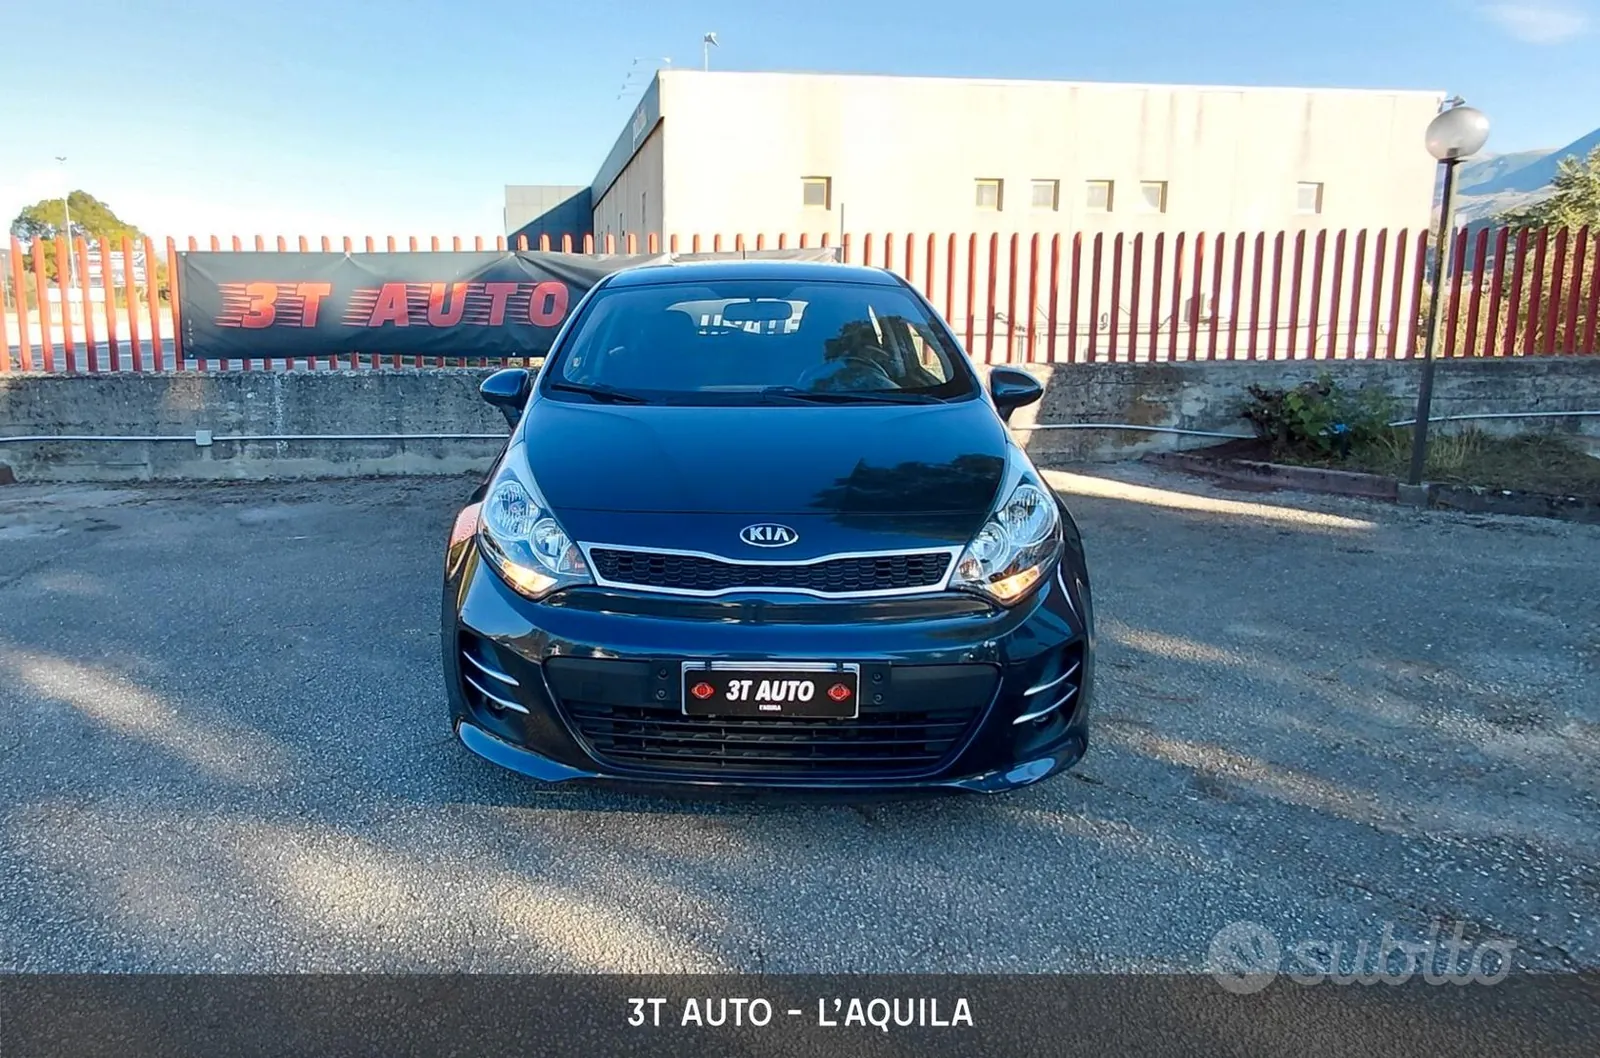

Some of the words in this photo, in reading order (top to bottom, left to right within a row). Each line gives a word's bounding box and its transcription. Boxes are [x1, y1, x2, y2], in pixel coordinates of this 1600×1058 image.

[215, 282, 331, 329] 3T
[342, 281, 569, 327] AUTO
[750, 527, 789, 541] KIA
[726, 680, 753, 701] 3T
[755, 680, 815, 702] AUTO
